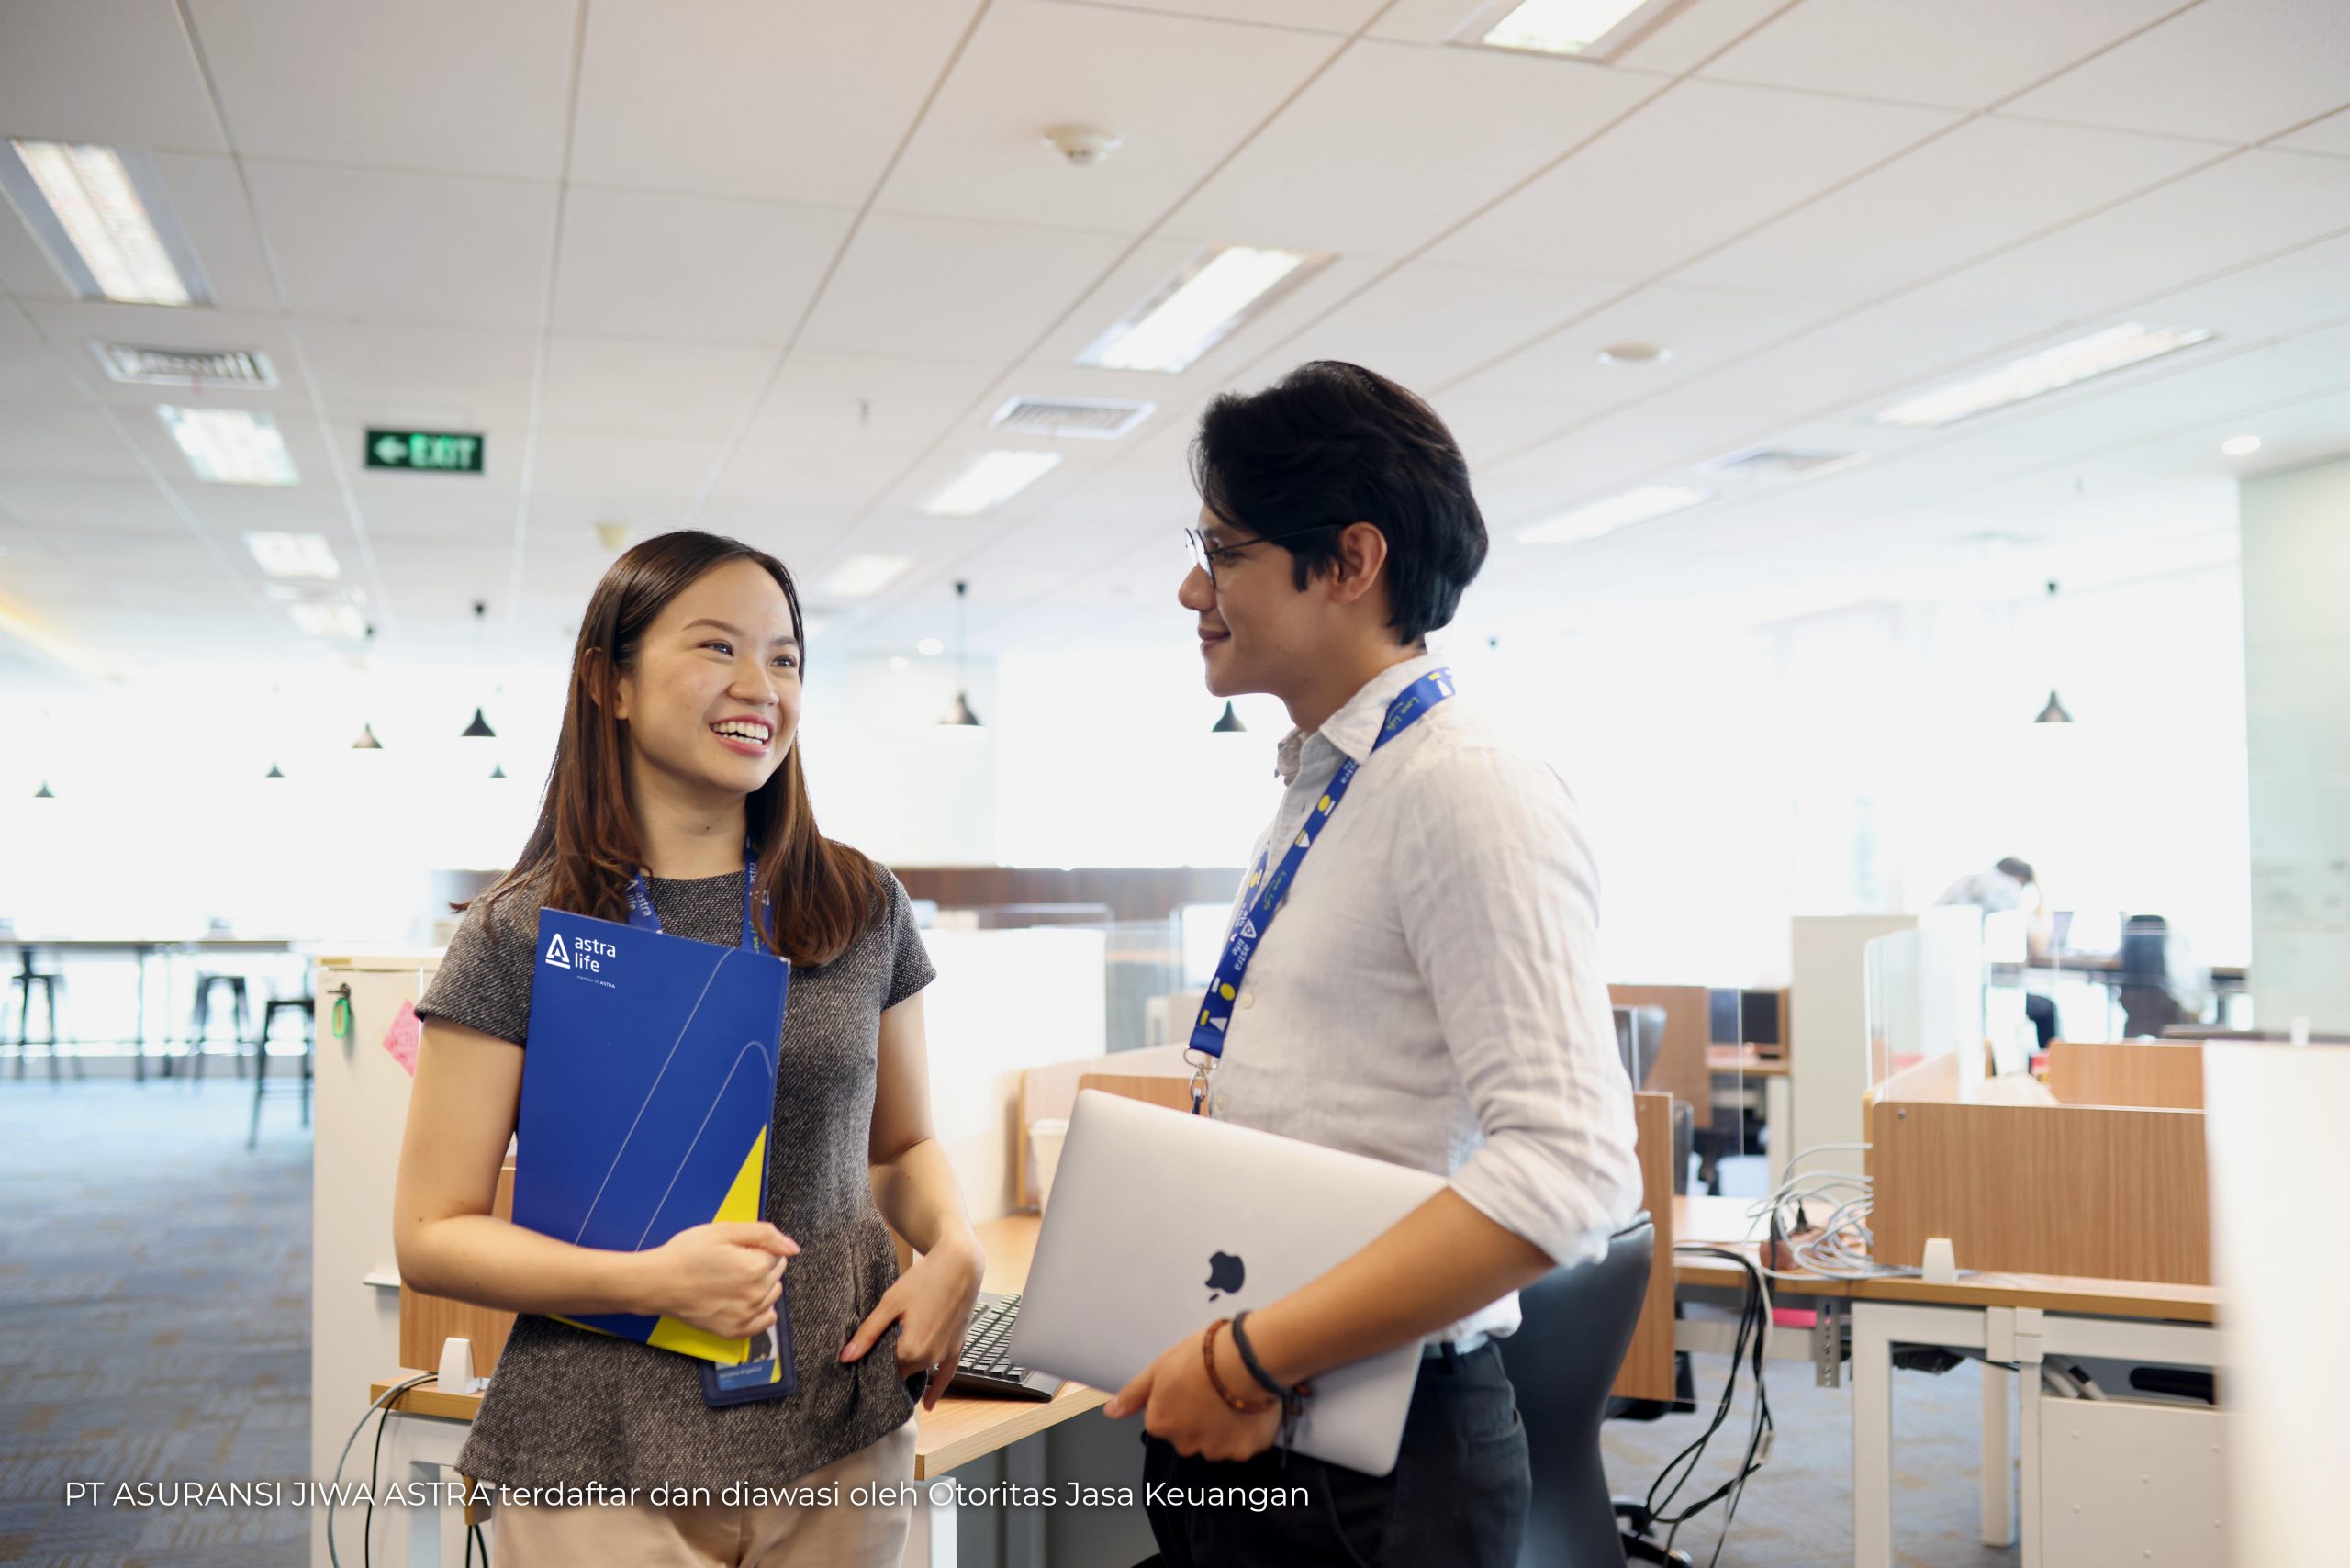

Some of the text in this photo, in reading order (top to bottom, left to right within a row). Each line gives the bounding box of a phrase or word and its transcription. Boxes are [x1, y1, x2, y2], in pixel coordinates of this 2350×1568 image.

[409, 433, 477, 469] EXIT
[635, 891, 652, 916] astra
[575, 936, 616, 958] astra
[1232, 937, 1245, 956] life
[1234, 944, 1250, 971] astra
[575, 952, 599, 973] life
[599, 980, 616, 989] ASTRA
